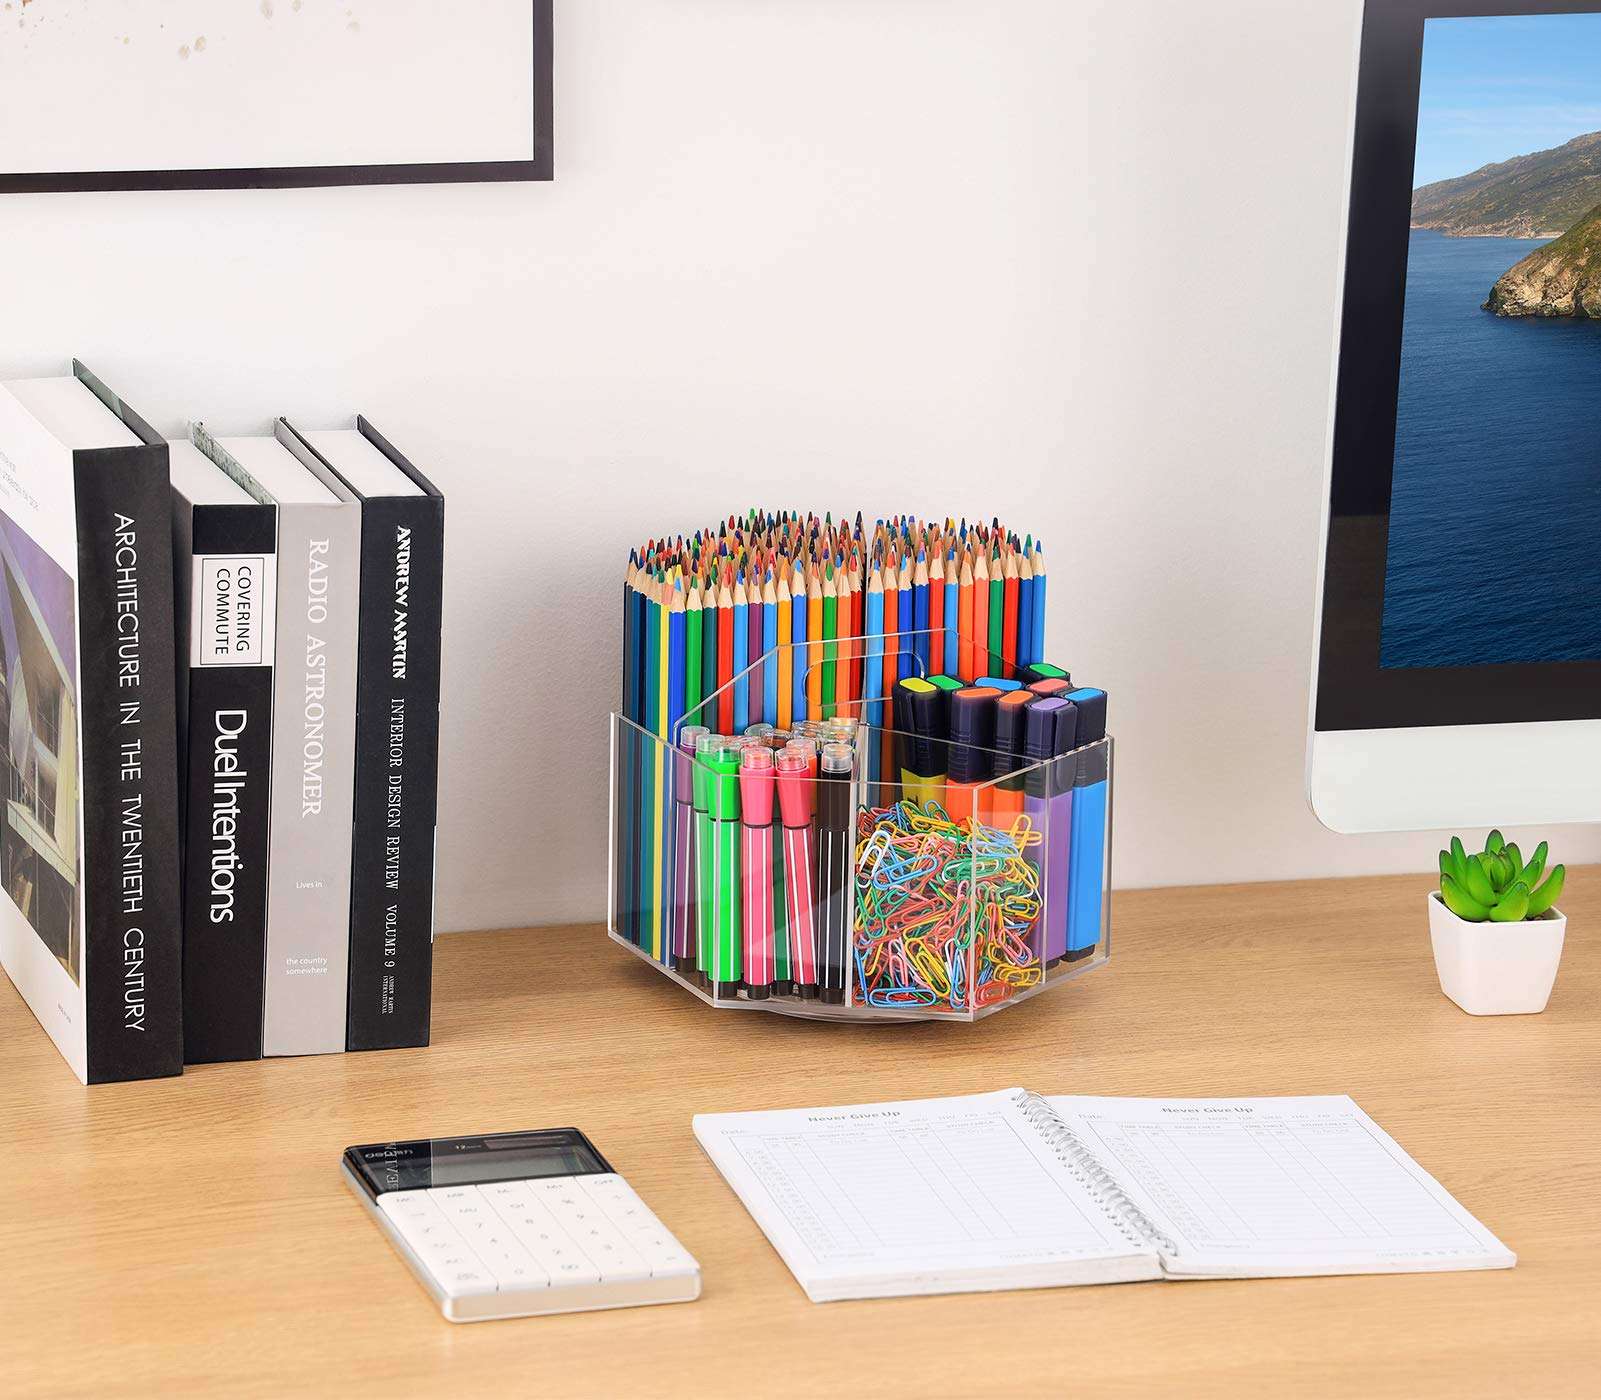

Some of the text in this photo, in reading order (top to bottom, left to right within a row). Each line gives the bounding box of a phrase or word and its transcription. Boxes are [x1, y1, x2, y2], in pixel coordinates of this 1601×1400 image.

[215, 568, 230, 655] COMMUTE
[236, 565, 251, 652] COVERING
[302, 537, 330, 819] RADIO ASTRONOMER
[113, 512, 145, 1032] ARCHITECTURE IN THE TWENTIETH CENTURY
[384, 525, 412, 968] ANDREW MARTIN INTERIOR DESIGN REVIEW VOLUME 9
[209, 709, 248, 923] Duel Intentions
[296, 880, 323, 889] Lives in
[286, 957, 328, 967] the country
[286, 966, 328, 975] somewhere
[808, 1115, 847, 1123] Never
[850, 1112, 880, 1120] Give
[881, 1110, 901, 1119] Up
[1160, 1107, 1200, 1115] Never
[1234, 1107, 1254, 1115] Up
